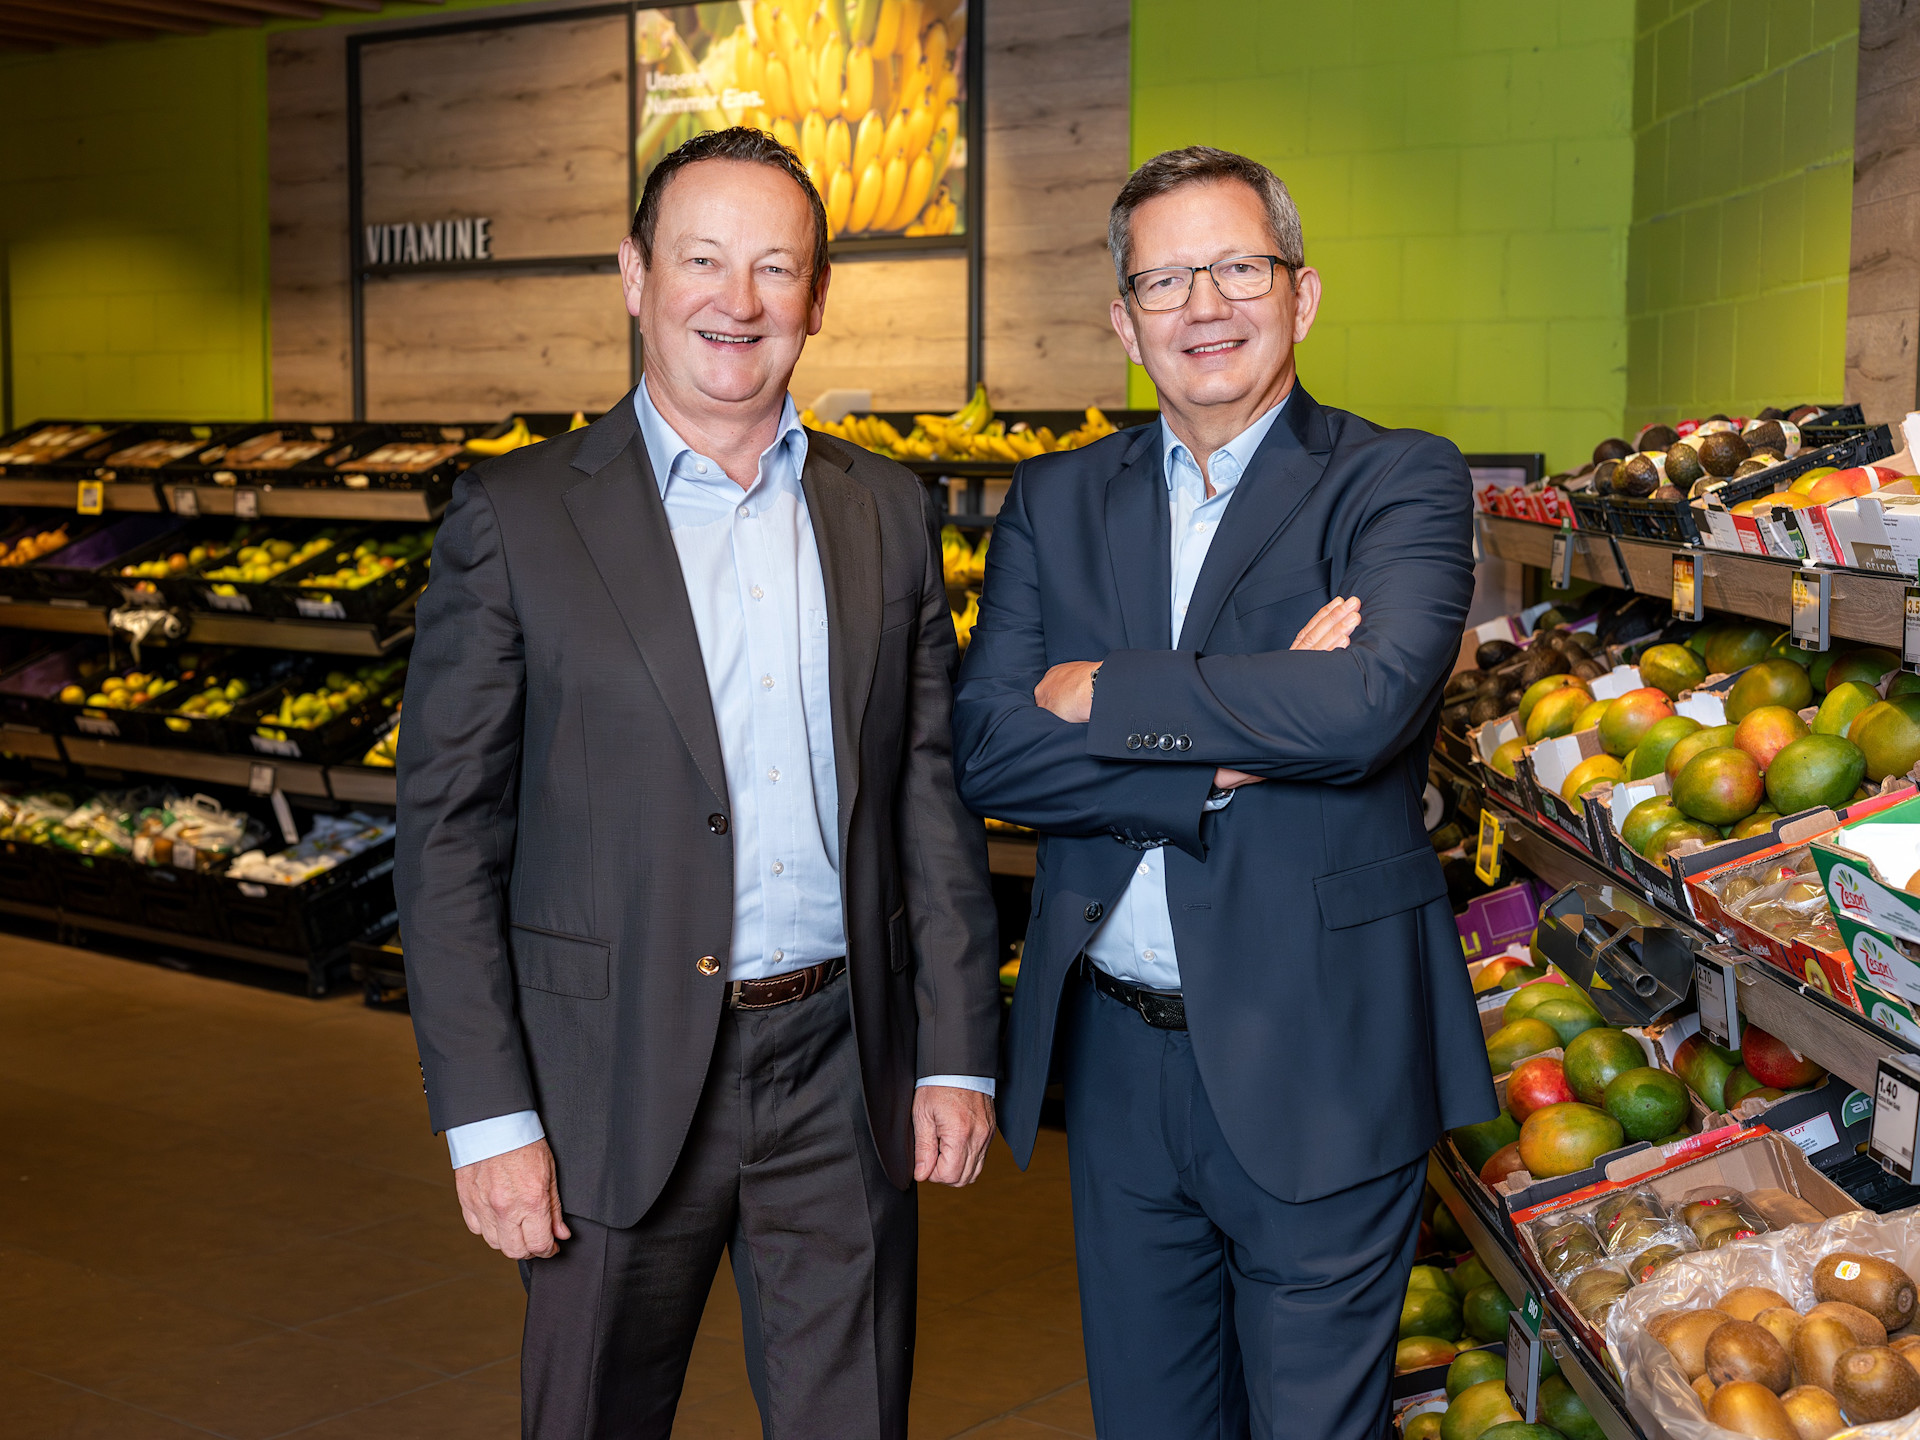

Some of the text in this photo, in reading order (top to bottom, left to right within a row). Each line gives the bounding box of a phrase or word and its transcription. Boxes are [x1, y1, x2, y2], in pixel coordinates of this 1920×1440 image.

[645, 95, 719, 114] Nummer
[366, 217, 489, 264] VITAMINE
[1834, 881, 1873, 913] Zespri
[1698, 966, 1712, 984] 2.70
[1858, 948, 1898, 982] Zespri
[1880, 1077, 1898, 1099] 1.40
[1789, 1125, 1806, 1137] LOT
[1527, 1298, 1539, 1320] BIO
